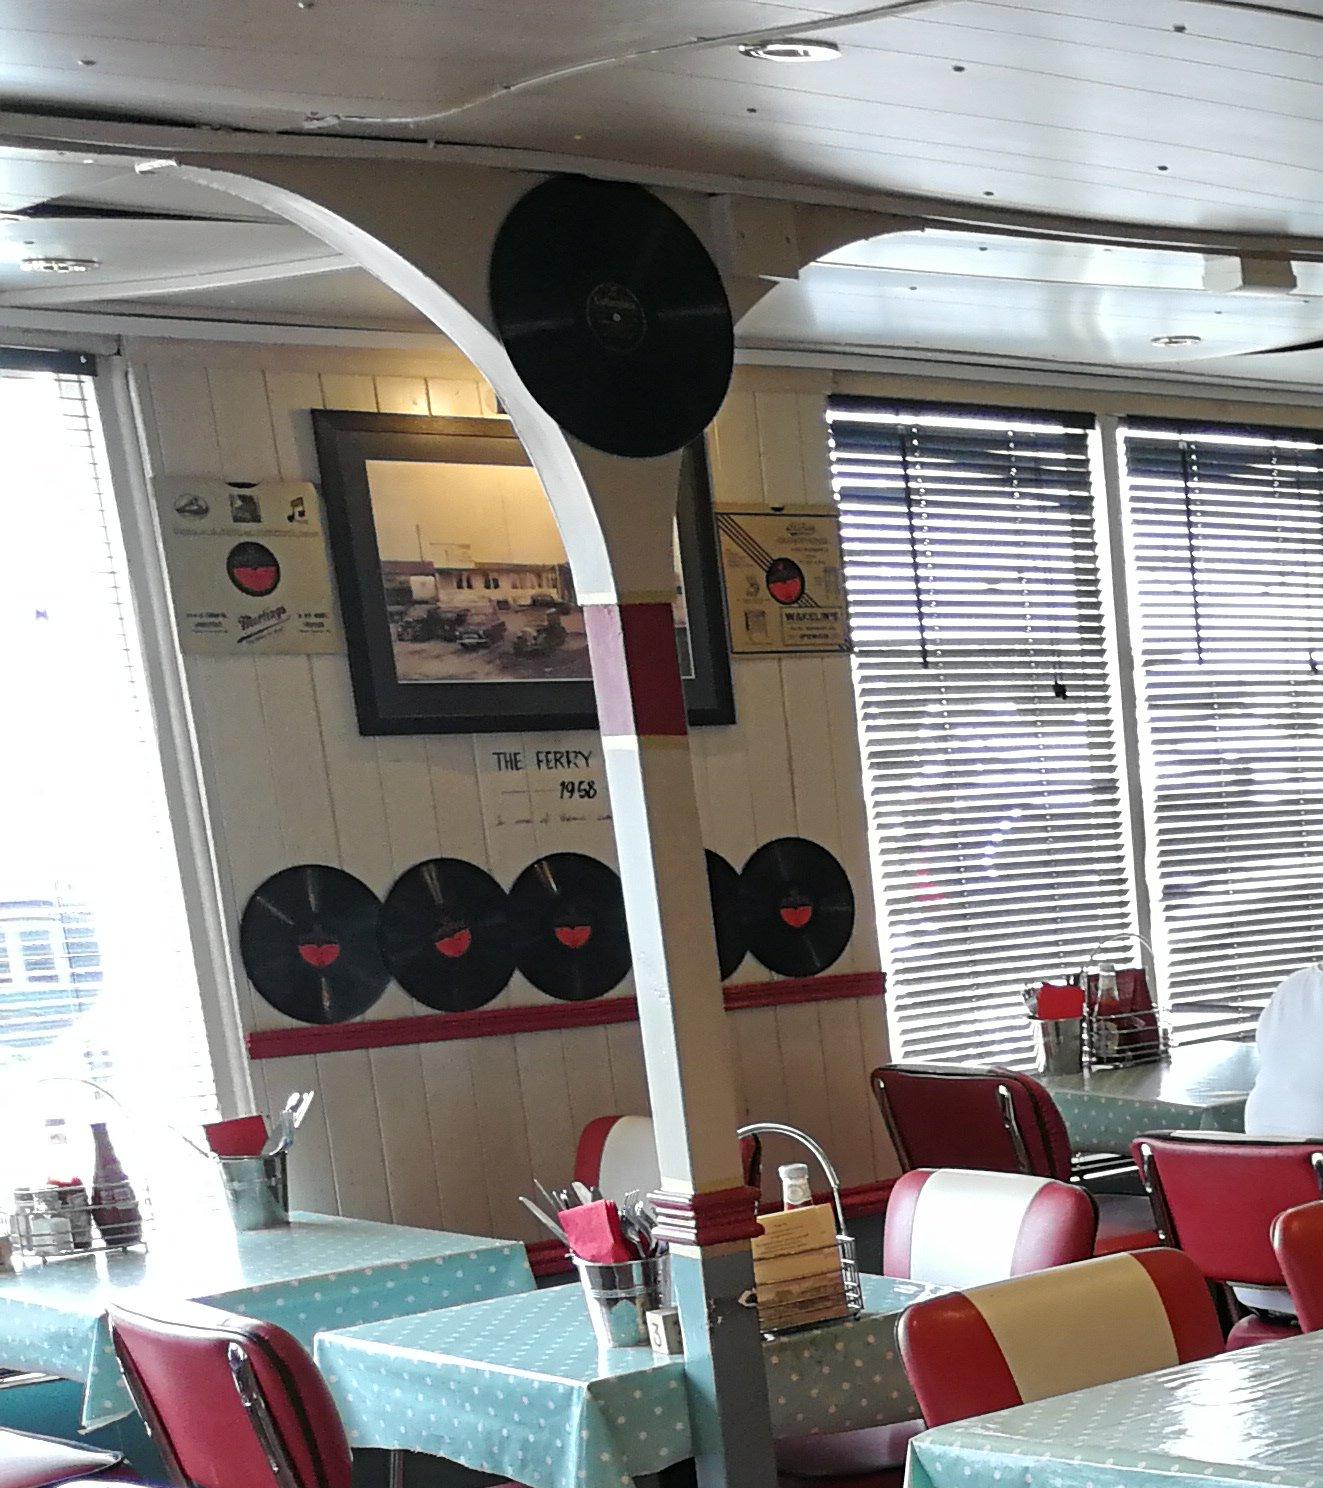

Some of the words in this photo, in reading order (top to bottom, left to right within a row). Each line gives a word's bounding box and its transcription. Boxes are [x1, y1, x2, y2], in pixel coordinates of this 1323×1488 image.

[493, 752, 523, 771] THE
[536, 750, 592, 771] FERRY
[651, 1322, 662, 1347] 3
